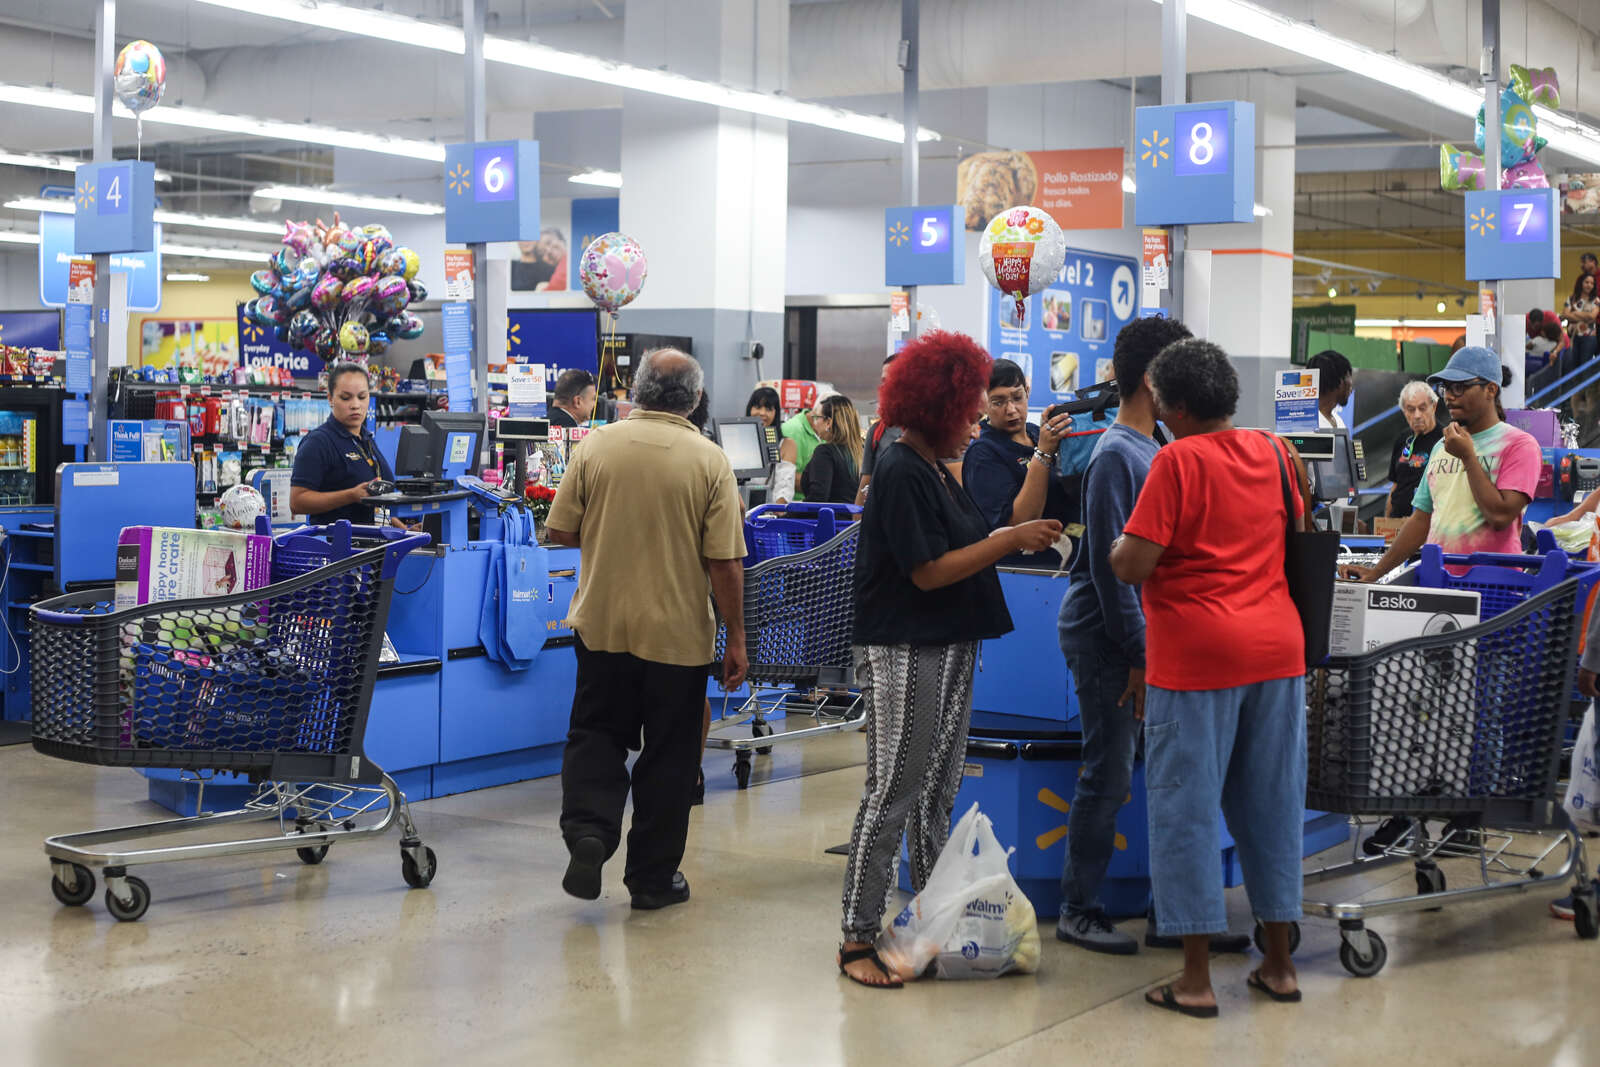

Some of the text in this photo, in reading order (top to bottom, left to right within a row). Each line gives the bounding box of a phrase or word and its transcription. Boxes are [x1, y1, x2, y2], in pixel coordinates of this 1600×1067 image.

[1189, 122, 1214, 165] 8
[484, 156, 504, 193] 6
[1043, 170, 1119, 184] Pollo Rostizado
[106, 175, 122, 209] 4
[1513, 203, 1534, 236] 7
[921, 217, 938, 247] 5
[997, 264, 1029, 276] Mother's
[1003, 257, 1023, 269] Happy
[1055, 259, 1095, 287] vel 2
[243, 344, 271, 354] Everyday
[244, 353, 273, 369] Low
[273, 351, 310, 370] Price
[511, 375, 526, 383] Save
[1276, 387, 1317, 399] Save $25
[114, 431, 129, 440] Think
[157, 531, 169, 569] home
[169, 532, 181, 576] crate
[512, 589, 530, 599] Walmart
[1369, 592, 1417, 609] Lasko
[966, 898, 1007, 914] Walm
